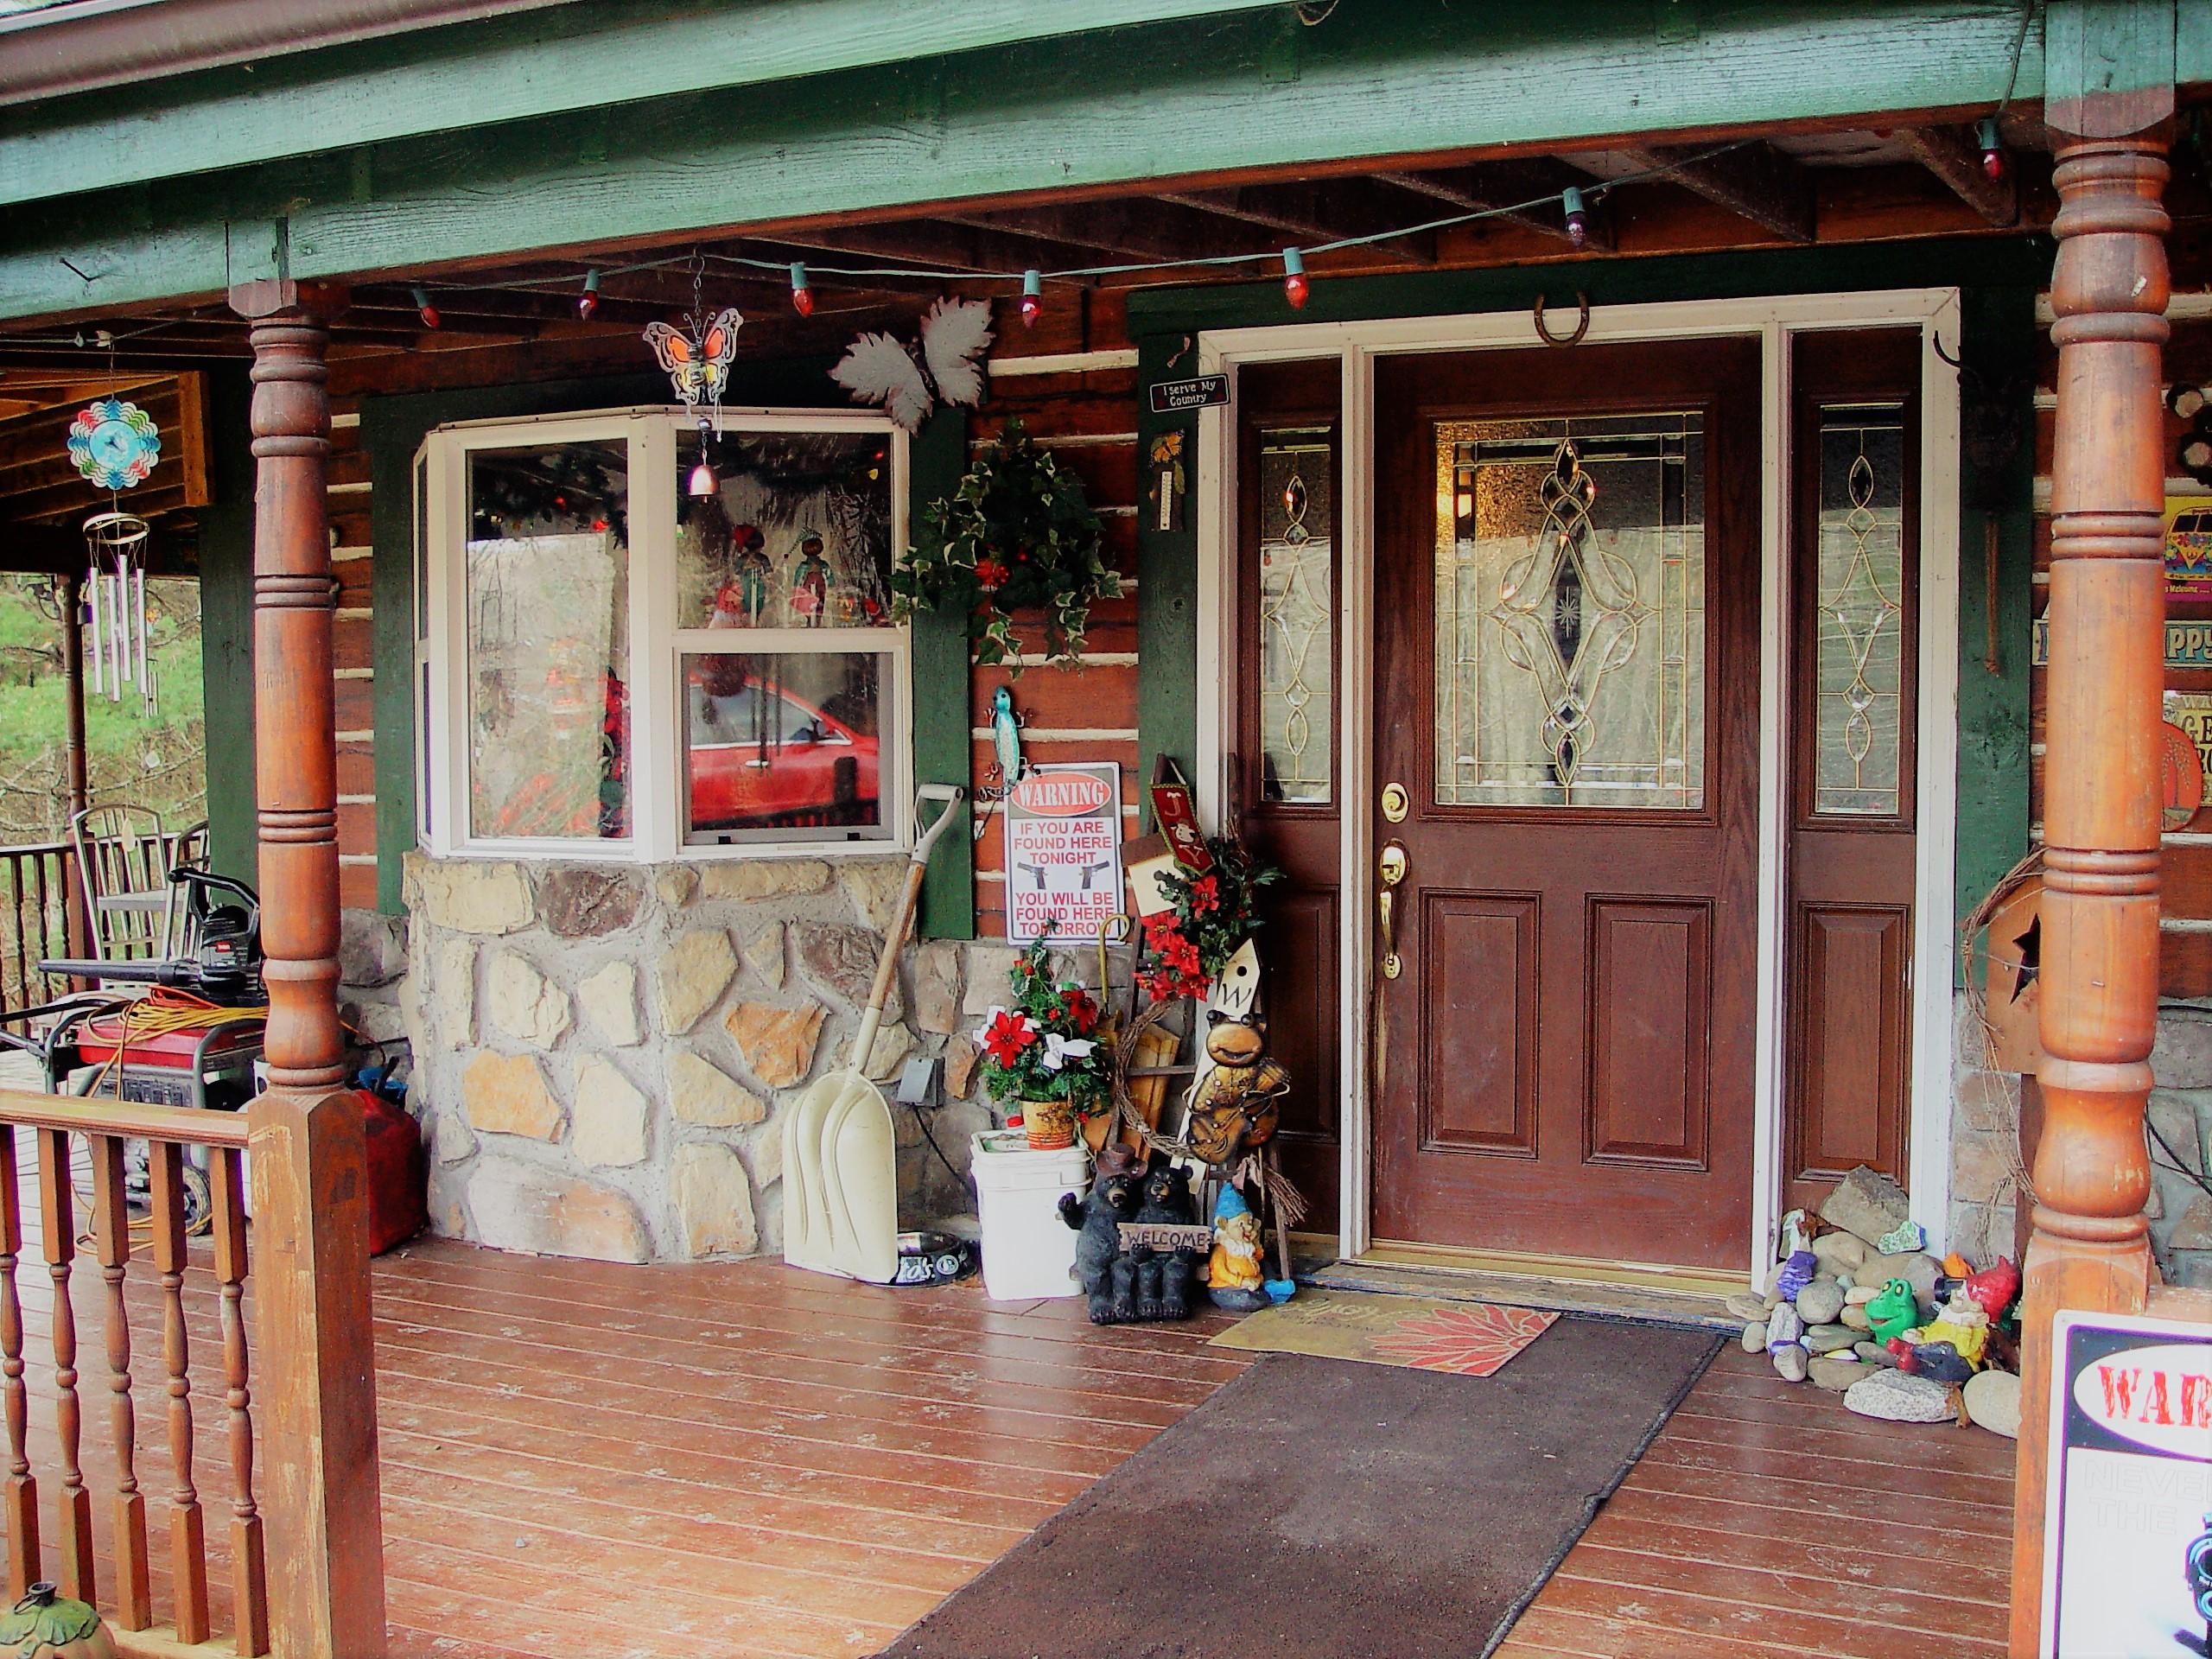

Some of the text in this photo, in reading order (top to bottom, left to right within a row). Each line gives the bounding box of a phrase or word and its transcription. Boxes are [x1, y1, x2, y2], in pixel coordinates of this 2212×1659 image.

[1163, 385, 1167, 396] I
[1202, 381, 1216, 391] My
[1169, 394, 1206, 406] Country
[1018, 781, 1105, 808] WARNING
[1020, 822, 1104, 836] IF YOU ARE
[1014, 836, 1112, 849] FOUND HERE
[1030, 852, 1096, 864] TONIGHT
[1015, 893, 1114, 906] YOU WILL BE
[1016, 907, 1115, 920] FOUND HERE
[1127, 1230, 1206, 1246] WELCOME
[2086, 1460, 2212, 1502] NEVE
[2088, 1496, 2177, 1535] THE
